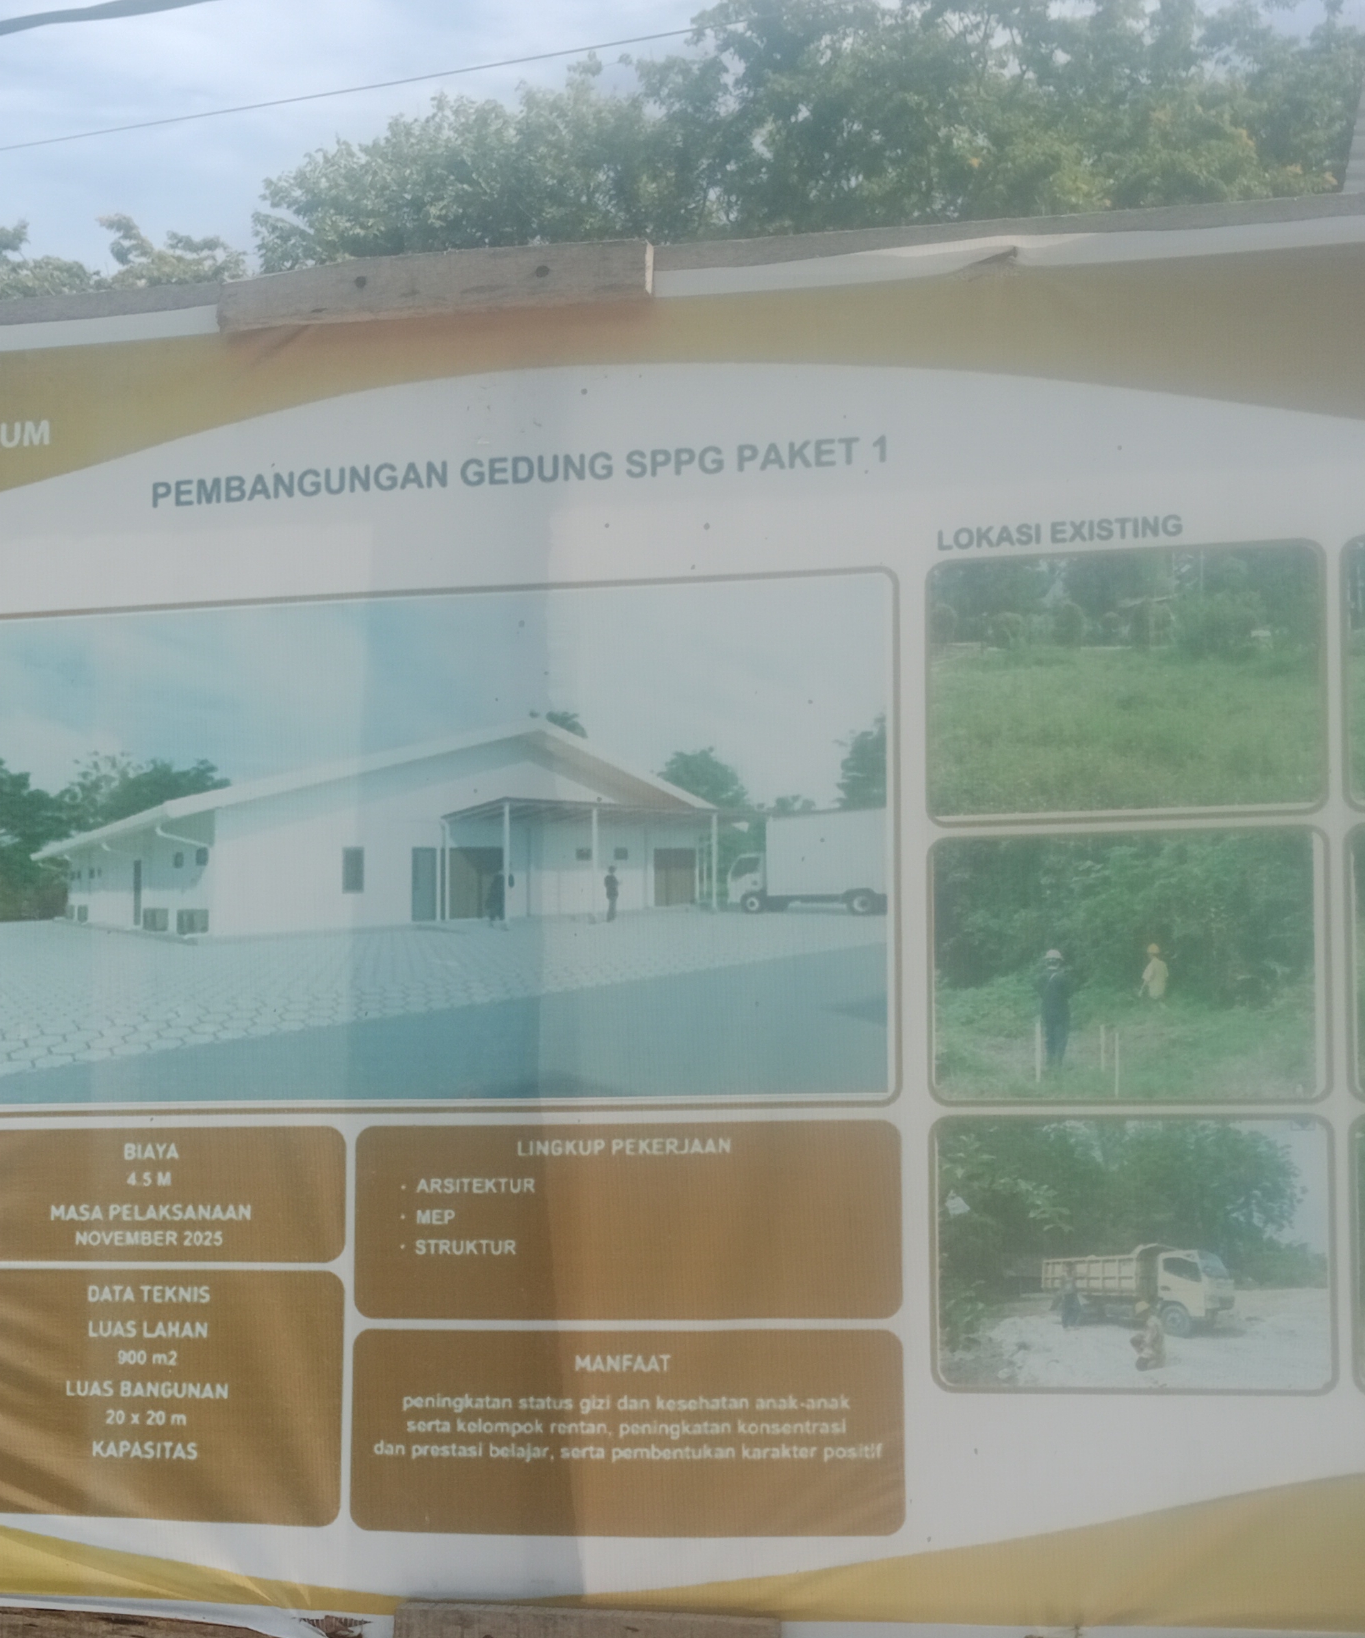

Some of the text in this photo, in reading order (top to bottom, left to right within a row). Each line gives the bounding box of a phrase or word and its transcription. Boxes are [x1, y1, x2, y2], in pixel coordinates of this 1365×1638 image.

[151, 435, 888, 508] PEMBANGUNGAN GEDUNG SPPG PAKET 1
[937, 514, 1184, 551] LOKASI EXISTING
[123, 1143, 180, 1161] BIAYA
[517, 1138, 732, 1157] LINGKUP PEKERJAAN
[157, 1171, 172, 1187] M
[415, 1177, 536, 1195] ARSITEKTUR
[50, 1204, 252, 1221] MASA PELAKSANAAN
[415, 1209, 456, 1225] MEP
[75, 1231, 223, 1247] NOVEMBER 2025
[415, 1238, 517, 1256] STRUKTUR
[87, 1285, 211, 1304] DATA TEKNIS
[88, 1320, 208, 1338] LUAS LAHAN
[117, 1350, 178, 1367] 900 m2
[574, 1355, 672, 1373] MANFAAT
[65, 1380, 229, 1399] LUAS BANGUNAN
[401, 1393, 850, 1414] peningkatan status gizi dan kesehatan anak-anak
[105, 1409, 187, 1426] 20 x 20 m
[406, 1418, 847, 1440] serta kelompok rentan, peningkatan konsentrasi
[92, 1440, 199, 1460] KAPASITAS
[373, 1440, 883, 1463] dan prestasi belajar, serta pembentukan karakter positif
